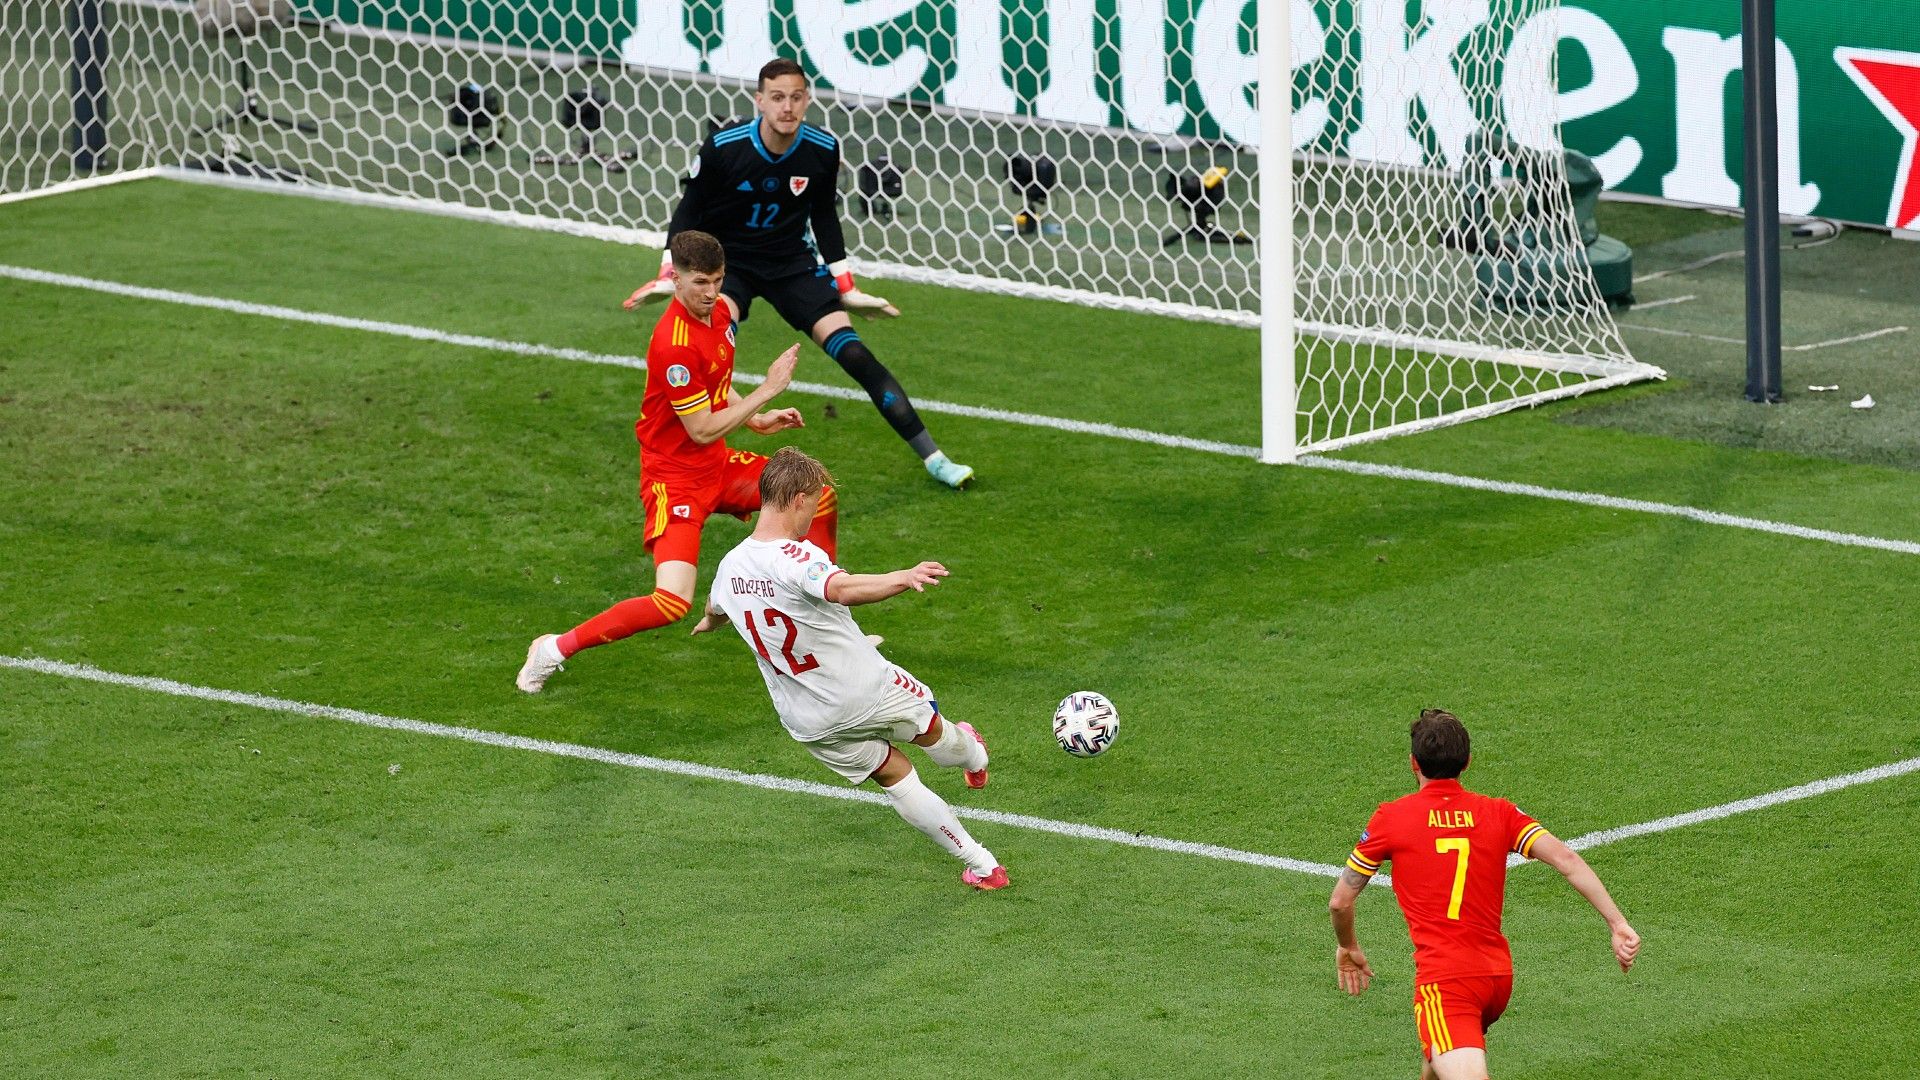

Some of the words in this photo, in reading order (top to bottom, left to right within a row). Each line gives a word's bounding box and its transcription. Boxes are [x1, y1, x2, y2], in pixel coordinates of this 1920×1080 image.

[620, 0, 1821, 215] eineken
[746, 203, 780, 228] 12
[744, 608, 820, 677] 12
[1428, 809, 1475, 828] ALLEN
[1435, 837, 1470, 920] 7
